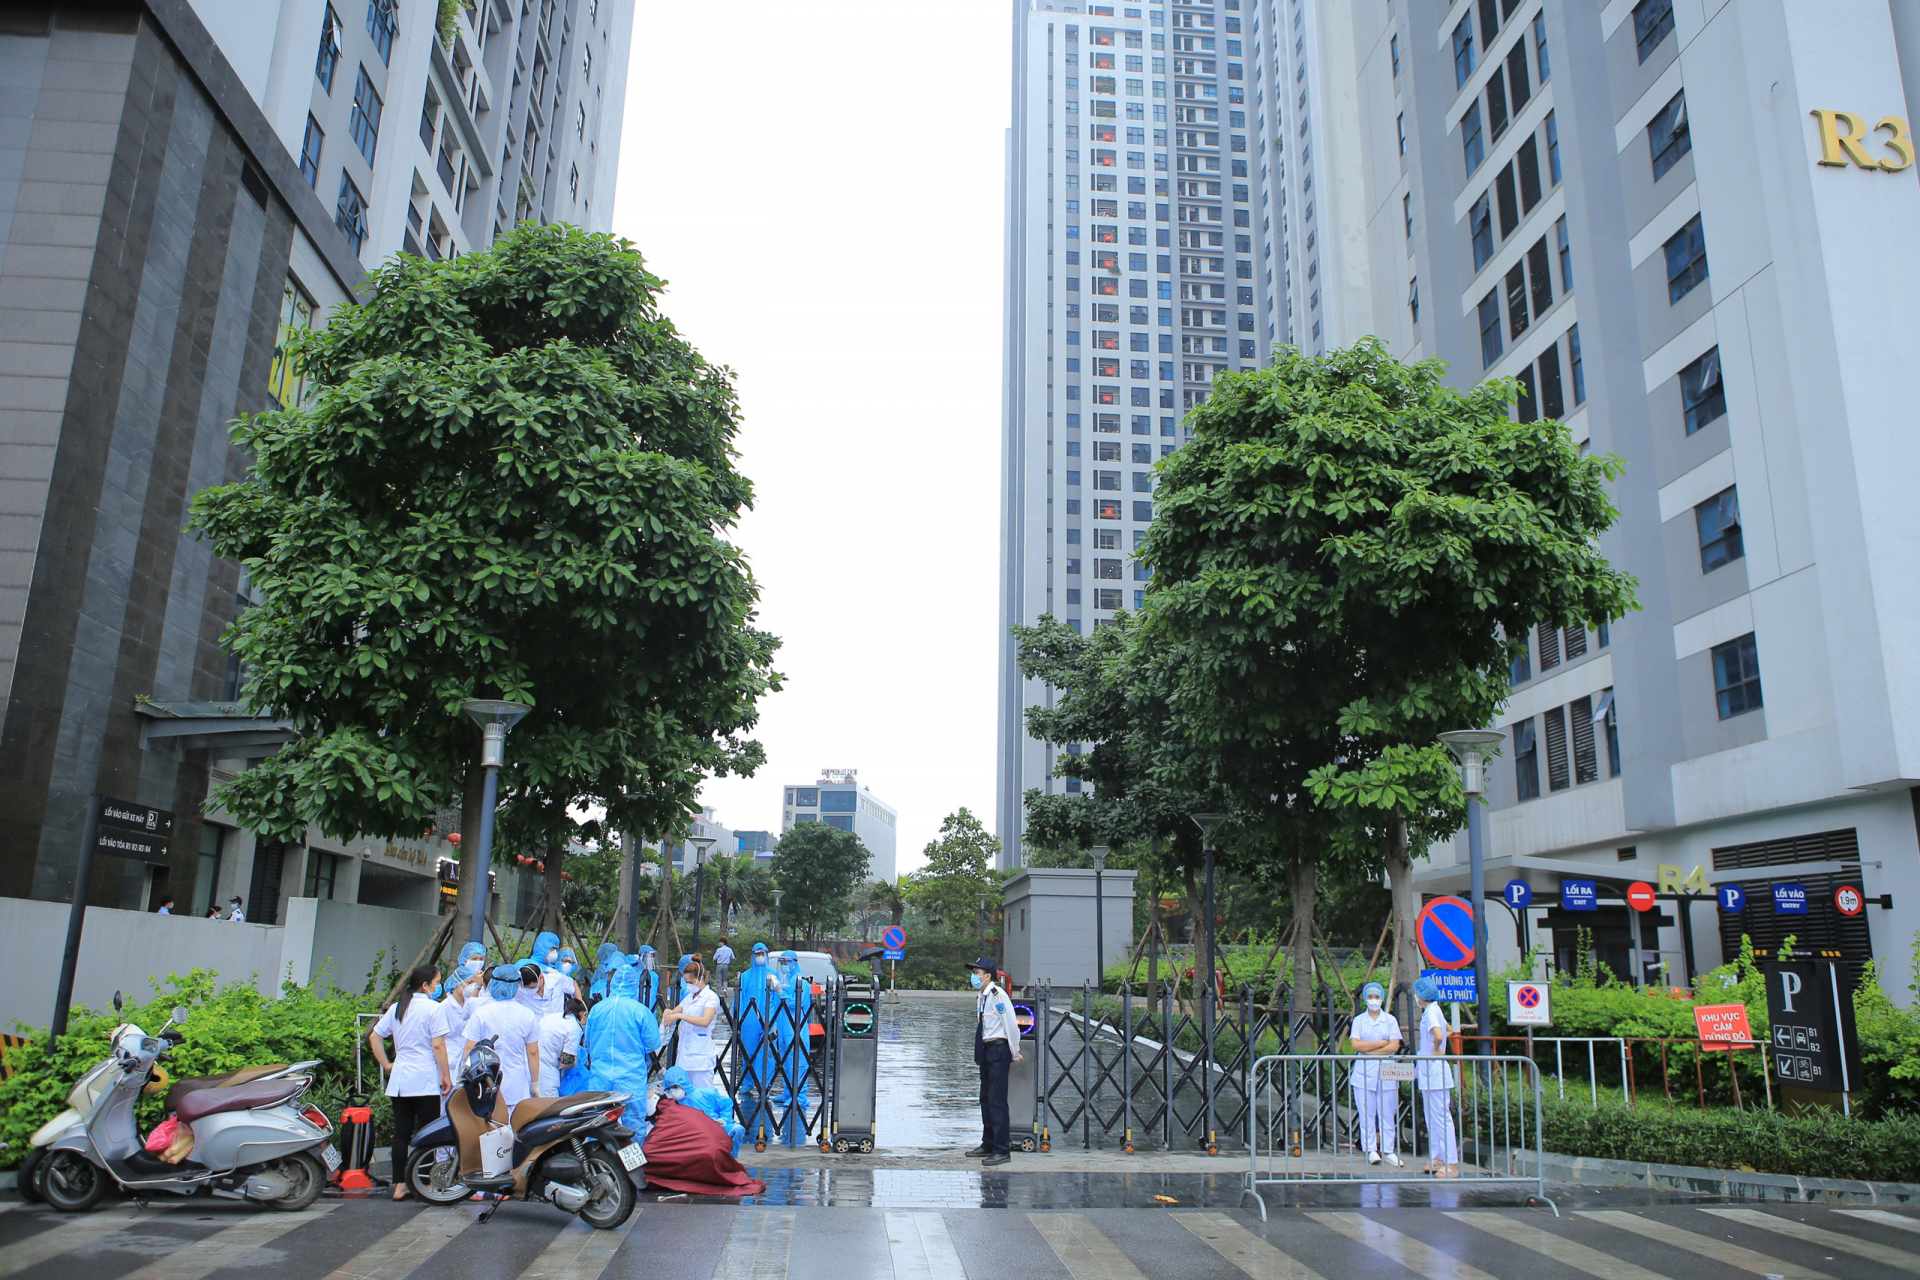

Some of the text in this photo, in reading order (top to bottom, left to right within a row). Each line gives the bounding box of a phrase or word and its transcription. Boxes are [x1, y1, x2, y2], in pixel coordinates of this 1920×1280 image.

[1809, 109, 1915, 172] R3
[113, 809, 121, 818] VÀO
[130, 814, 136, 822] XE
[108, 838, 116, 847] VÀO
[1656, 864, 1710, 895] R4
[1510, 884, 1525, 903] P
[1566, 884, 1579, 894] LỐI
[1775, 888, 1805, 898] LỐI VÀO
[1725, 889, 1739, 908] P
[1443, 974, 1464, 986] DỪNG
[1464, 976, 1476, 986] XE
[1448, 990, 1453, 999] 5
[1454, 988, 1473, 1000] PHÚT
[1778, 971, 1802, 1012] P
[1701, 1012, 1741, 1022] KHU VỰC
[1808, 1027, 1817, 1037] B1
[1810, 1042, 1821, 1052] B2
[1813, 1066, 1822, 1076] B1
